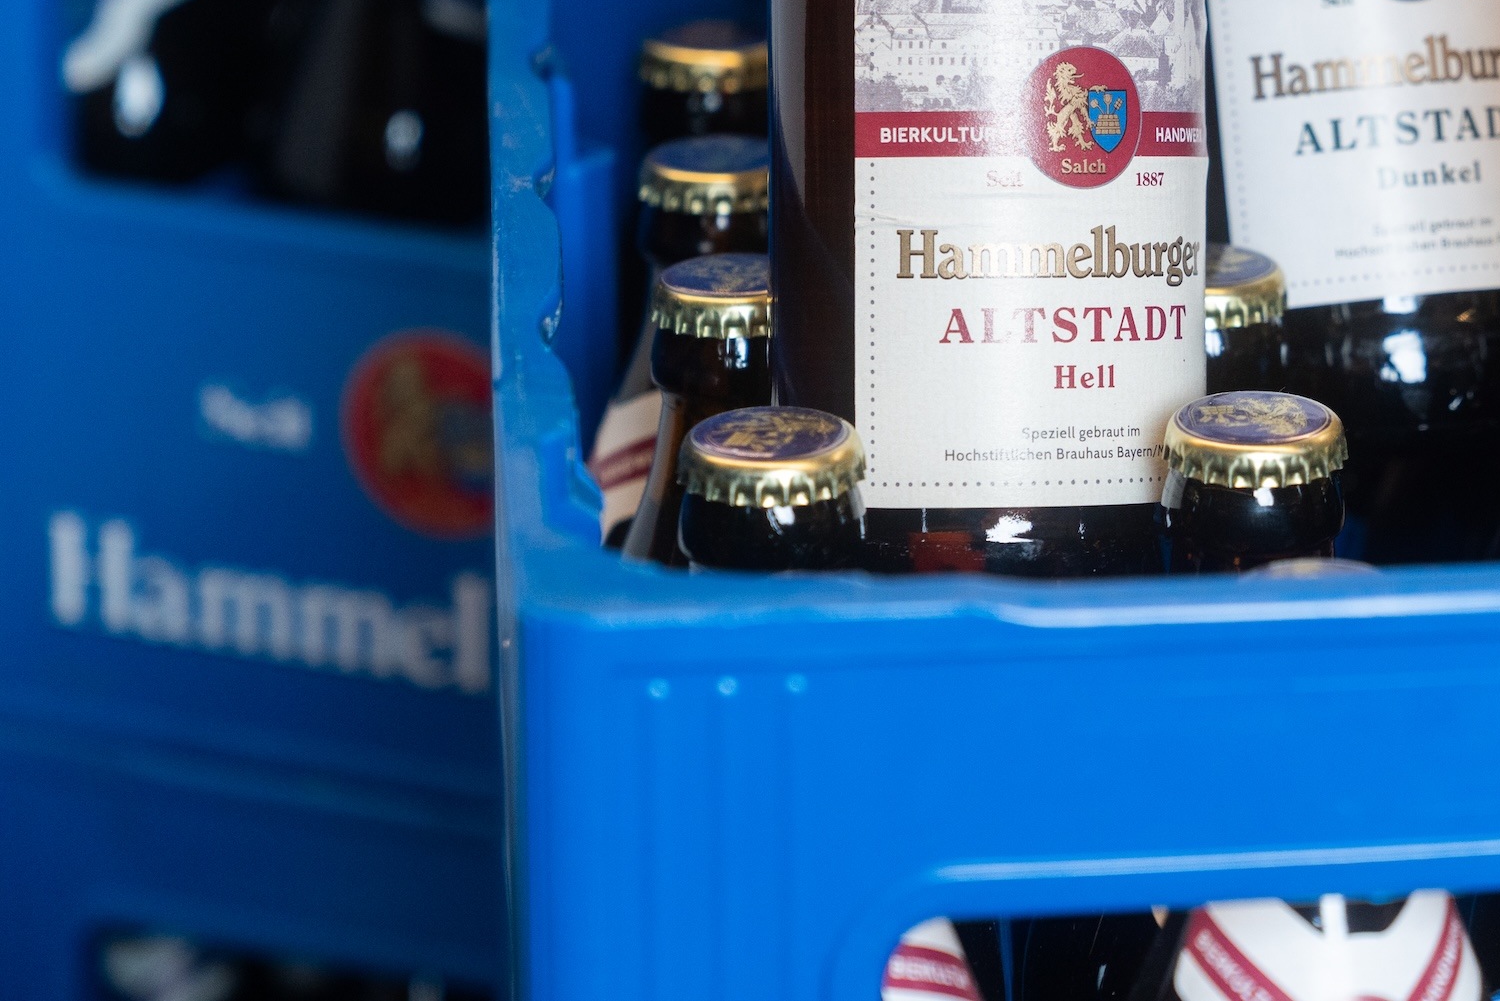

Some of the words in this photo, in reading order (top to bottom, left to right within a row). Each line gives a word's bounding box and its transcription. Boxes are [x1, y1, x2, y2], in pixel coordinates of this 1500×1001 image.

[1060, 157, 1108, 176] Salch
[1376, 161, 1483, 190] Dunkel
[985, 169, 1025, 188] Seit
[1135, 171, 1165, 187] 1887
[896, 224, 1200, 287] Hammelburger
[938, 304, 1187, 344] ALTSTADT
[1053, 364, 1116, 390] Hell
[1021, 426, 1076, 442] Speziell
[1078, 425, 1125, 441] gebraut
[1126, 425, 1141, 438] im
[1055, 446, 1114, 460] Brauhaus
